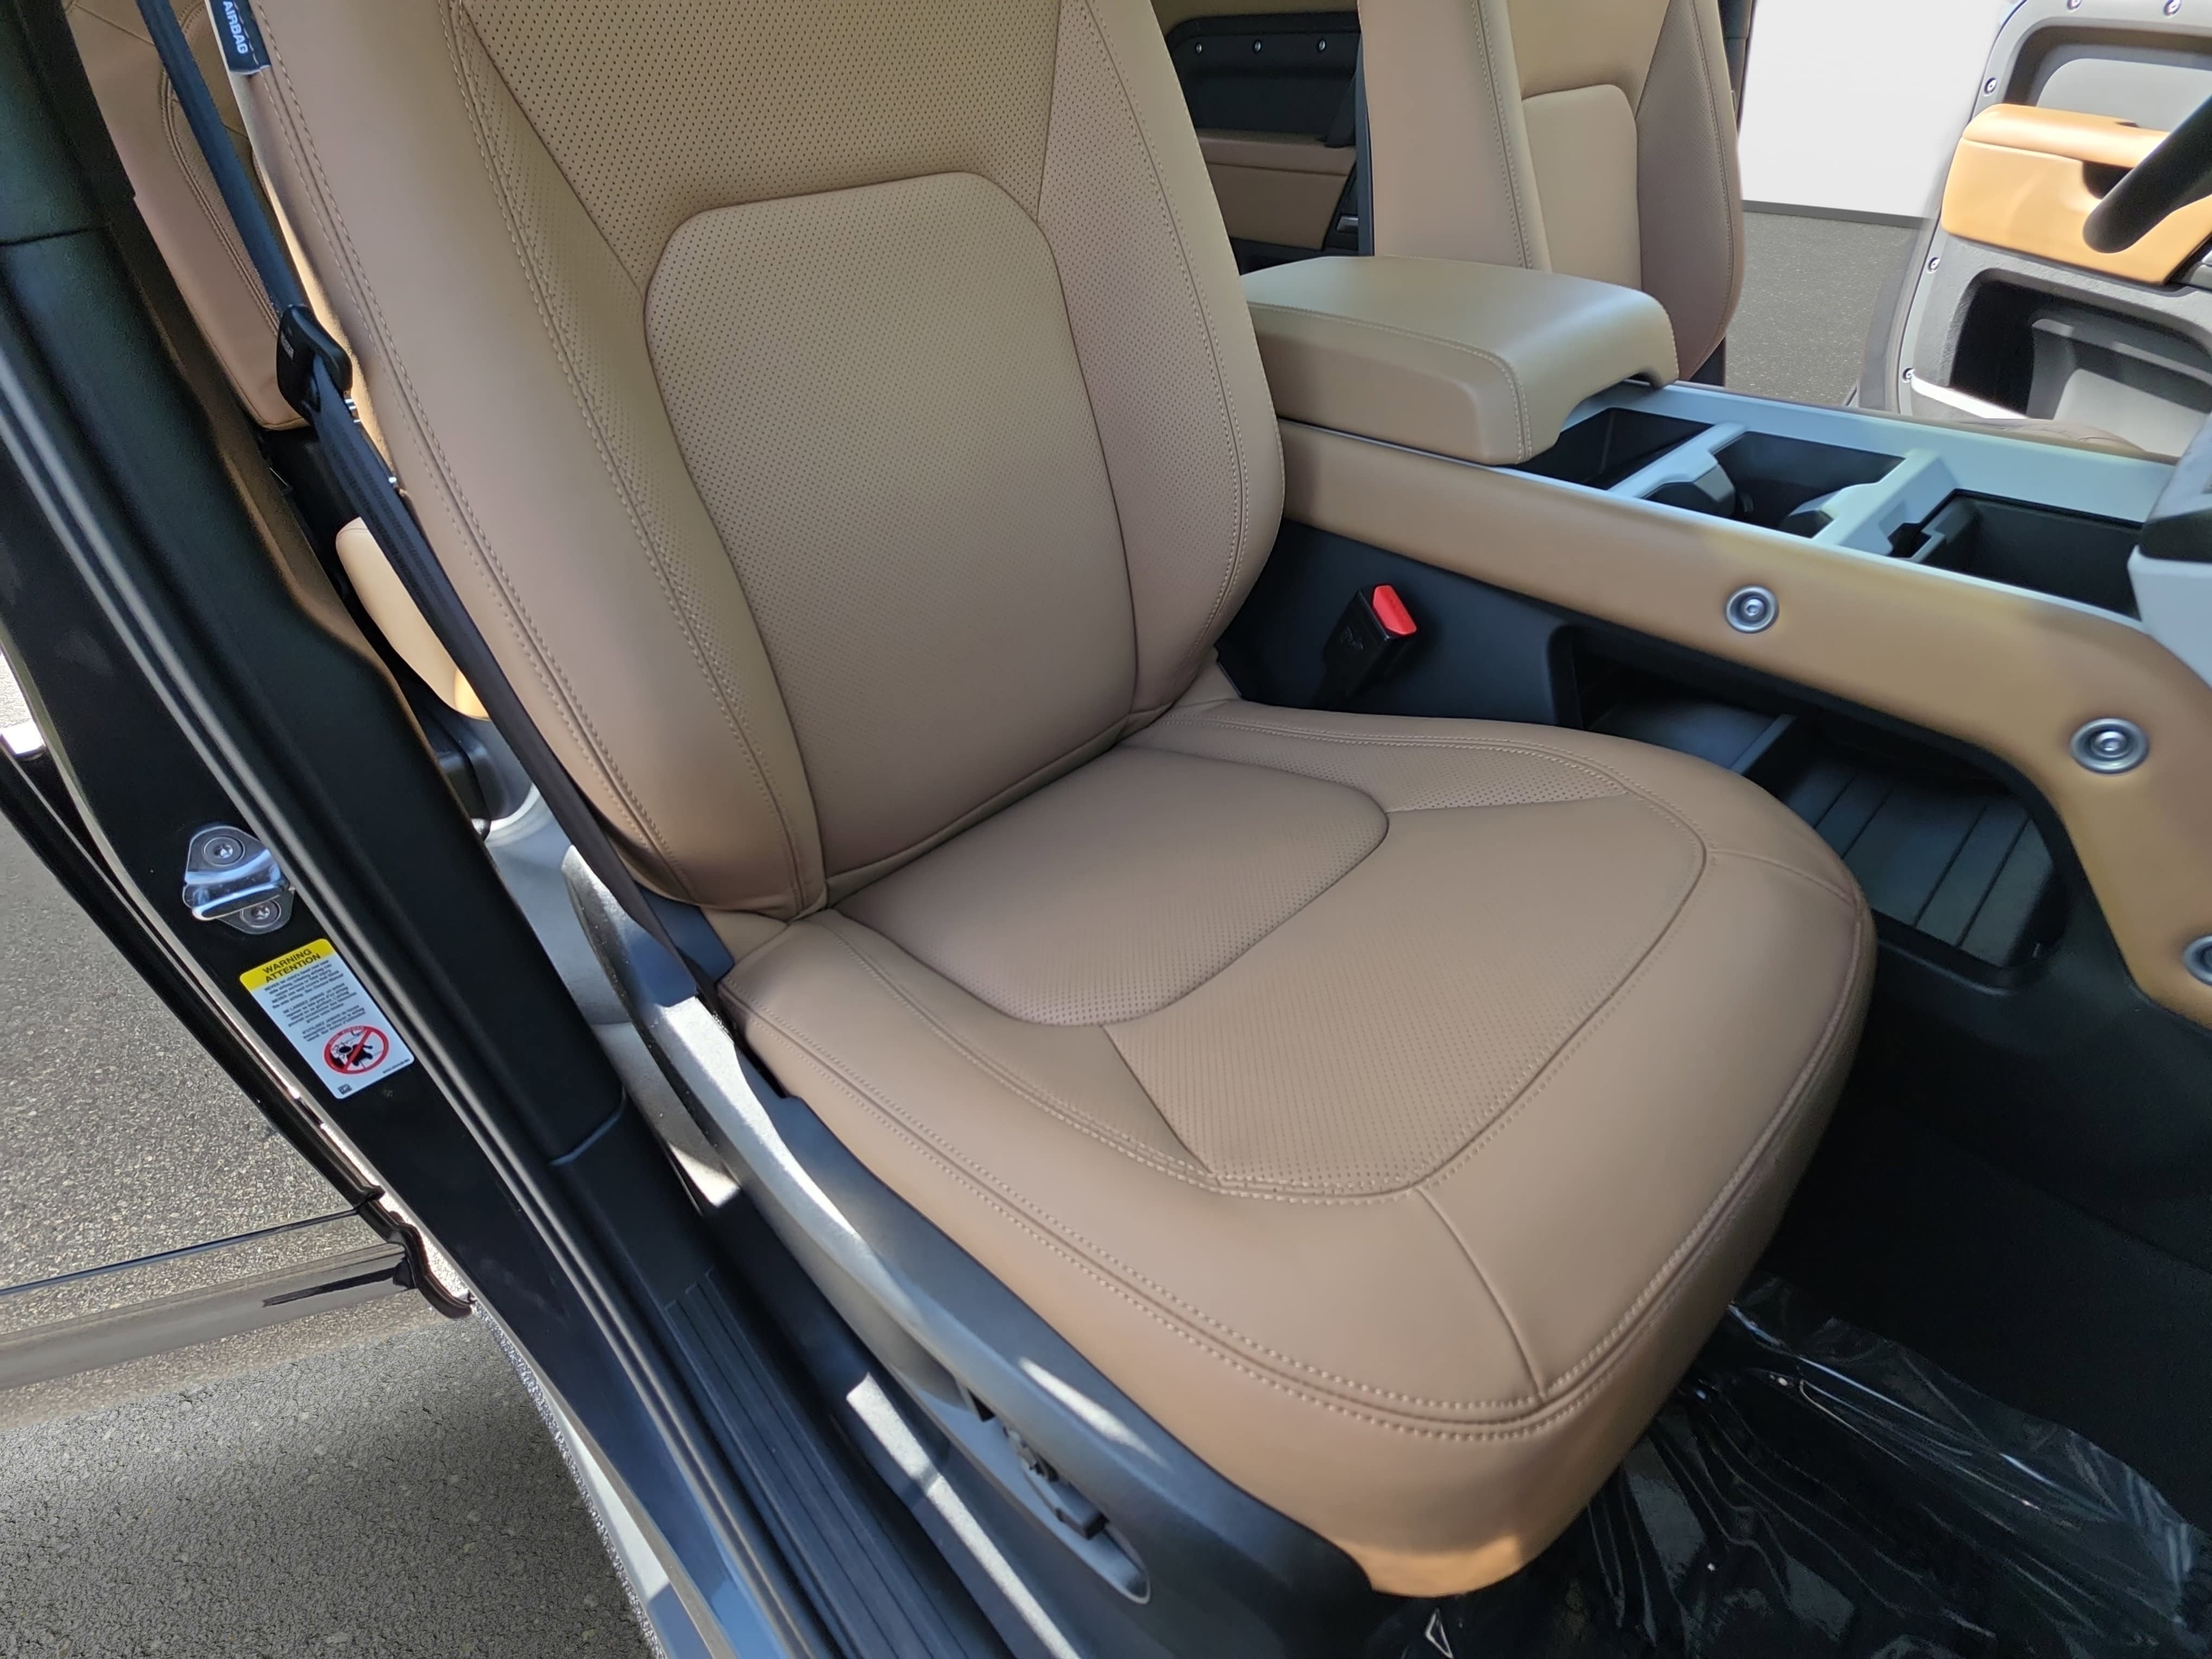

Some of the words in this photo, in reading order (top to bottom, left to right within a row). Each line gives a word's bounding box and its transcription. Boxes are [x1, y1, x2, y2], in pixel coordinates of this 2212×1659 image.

[223, 1, 248, 54] AIRBAG
[262, 948, 313, 974] WARNING
[265, 953, 321, 983] ATTENTION
